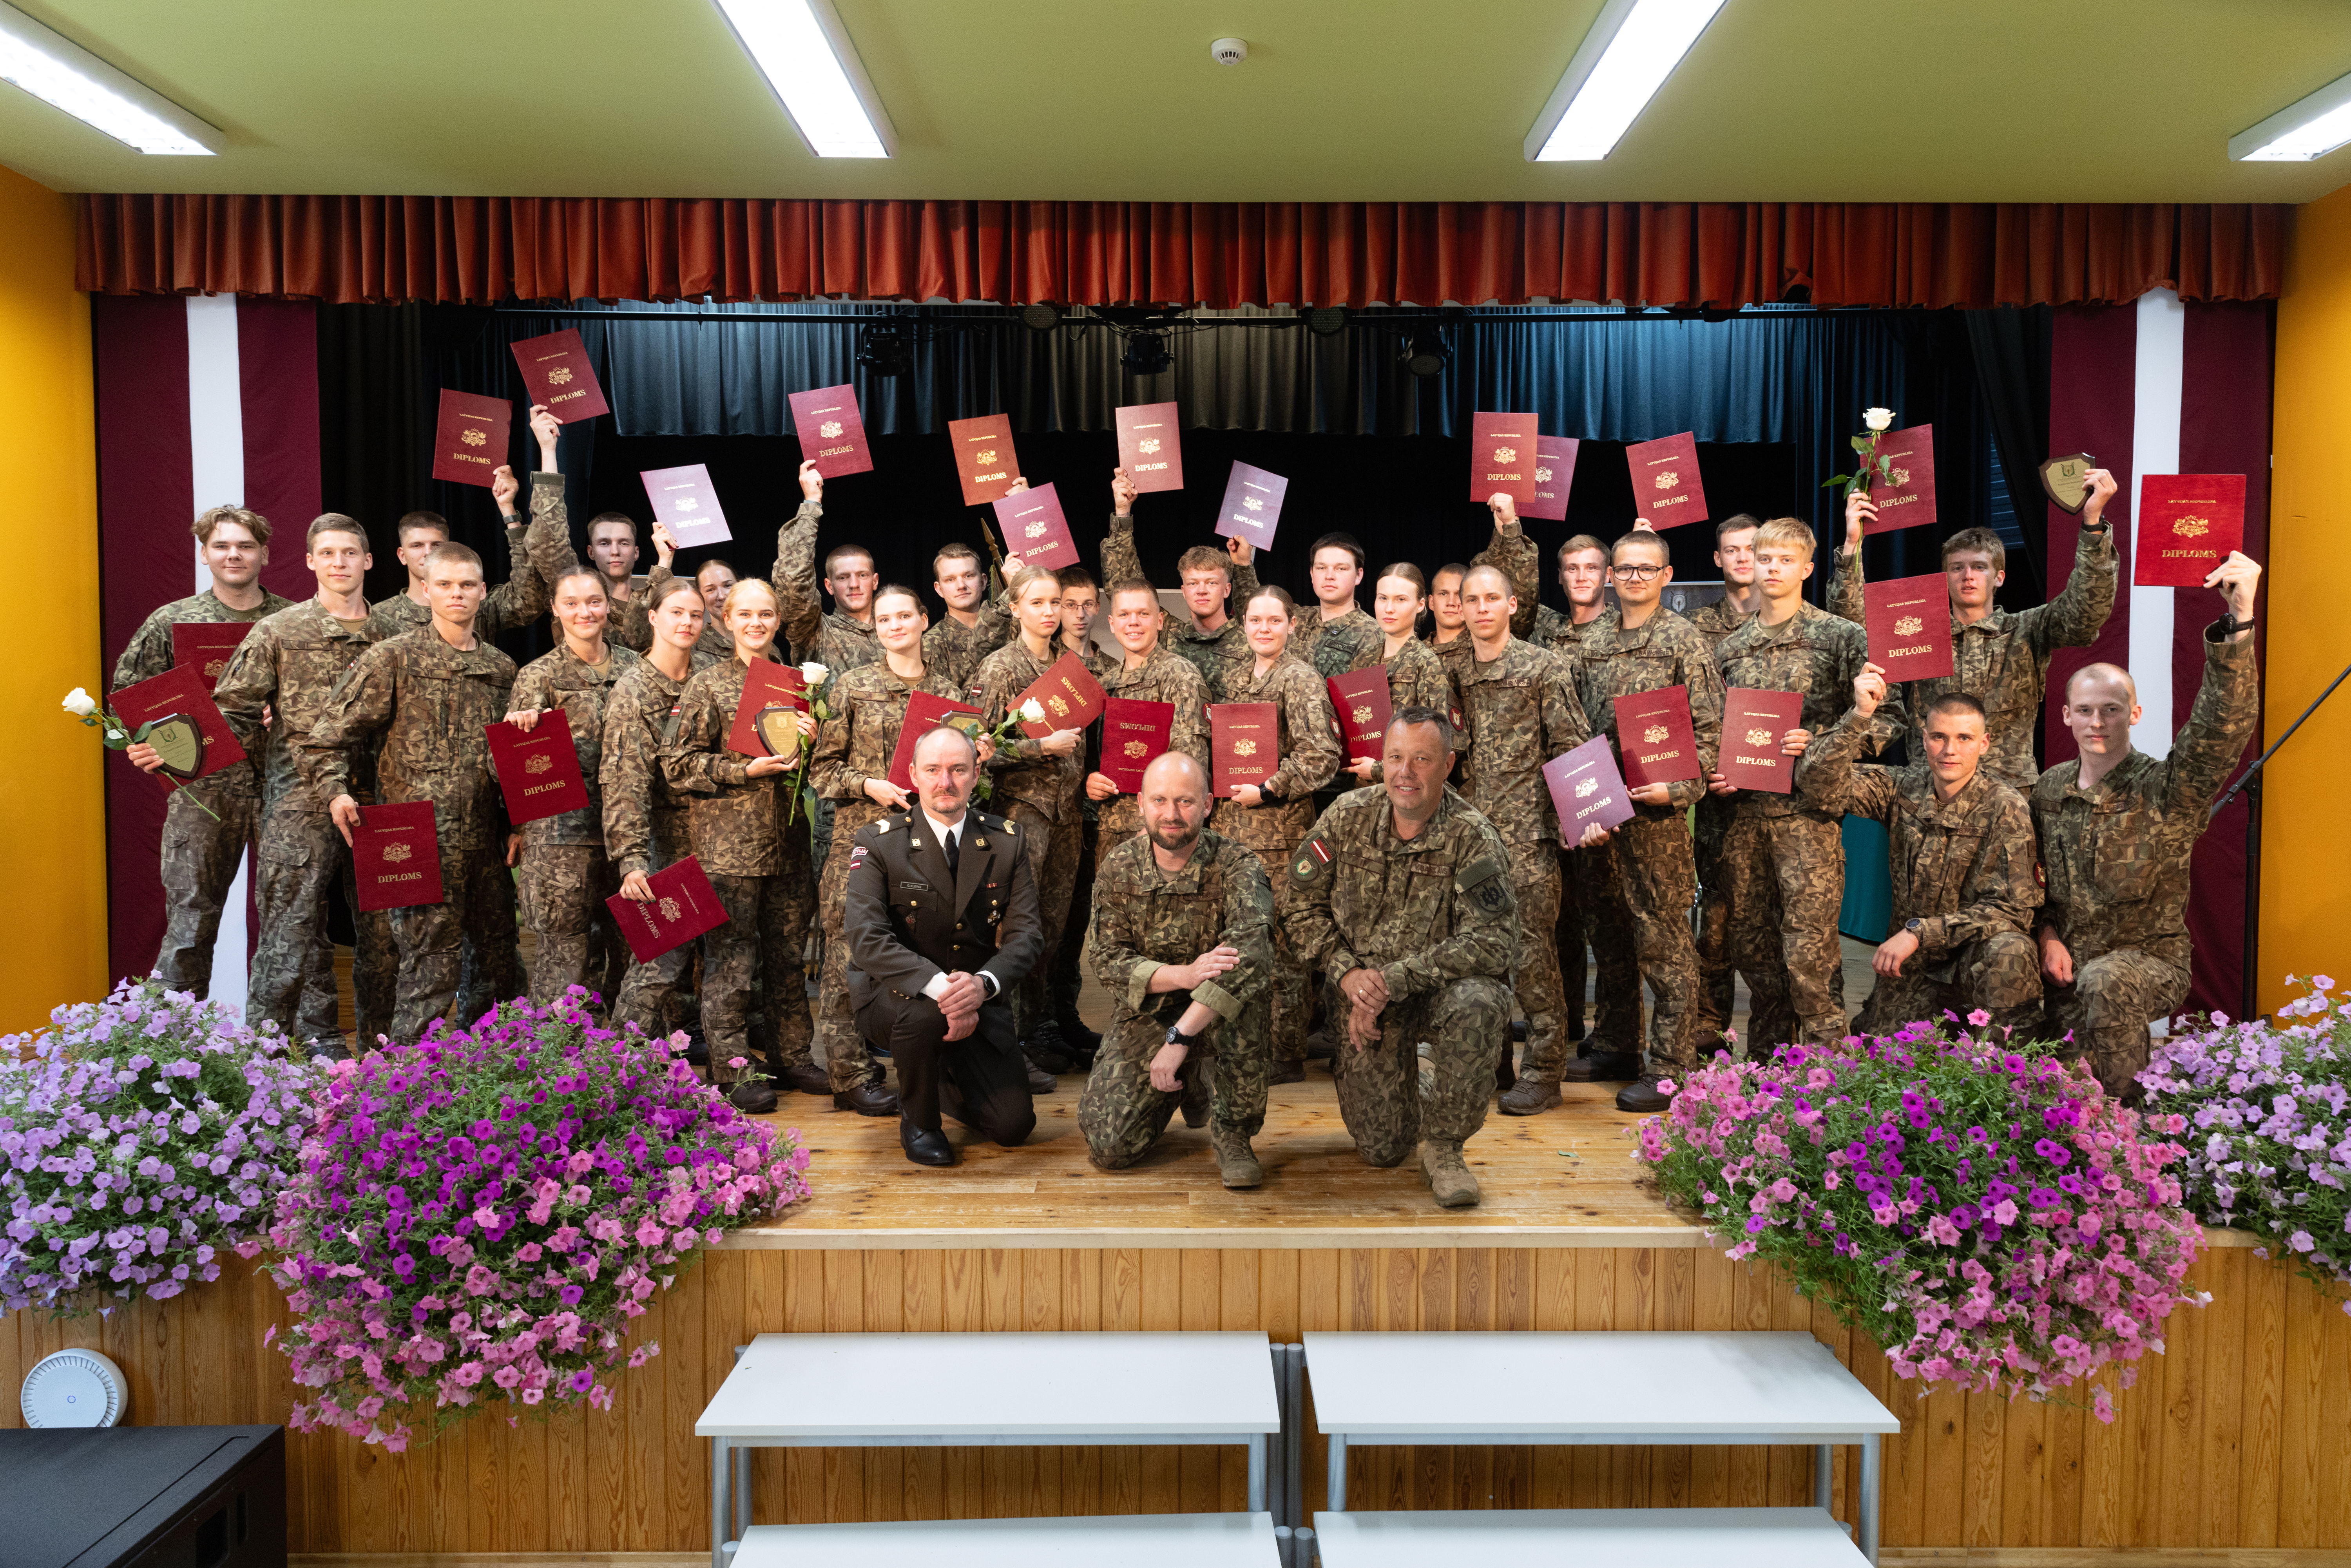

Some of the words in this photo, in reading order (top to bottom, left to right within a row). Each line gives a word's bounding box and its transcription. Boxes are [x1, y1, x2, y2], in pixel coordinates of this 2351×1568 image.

[550, 389, 586, 404] DIPLOMS
[819, 445, 854, 457] DIPLOMS
[453, 453, 491, 465] DIPLOMS
[1135, 462, 1167, 472] DIPLOMS
[975, 472, 1007, 483] DIPLOMS
[1653, 495, 1688, 508] DIPLOMS
[1880, 494, 1918, 508] DIPLOMS
[675, 517, 711, 529] DIPLOMS
[1233, 514, 1263, 529] DIPLOMS
[1026, 541, 1059, 557] DIPLOMS
[2162, 550, 2217, 558] DIPLOMS
[1888, 645, 1933, 657] DIPLOMS
[1061, 677, 1087, 707] DIPLOMS
[144, 701, 162, 712] LATVIJAS
[162, 694, 184, 704] REPUBLIKA
[1120, 722, 1156, 731] DIPLOMS
[530, 737, 551, 745] REPUBLIKA
[1350, 731, 1382, 743] DIPLOMS
[1641, 750, 1679, 764] DIPLOMS
[1736, 756, 1776, 767] DIPLOMS
[1565, 769, 1579, 779] LATVIJAS
[1578, 760, 1595, 771] REPUBLIKA
[523, 780, 566, 796] DIPLOMS
[1576, 797, 1612, 820] DIPLOMS
[378, 872, 422, 883] DIPLOMS
[637, 902, 661, 938] DIPLOMS
